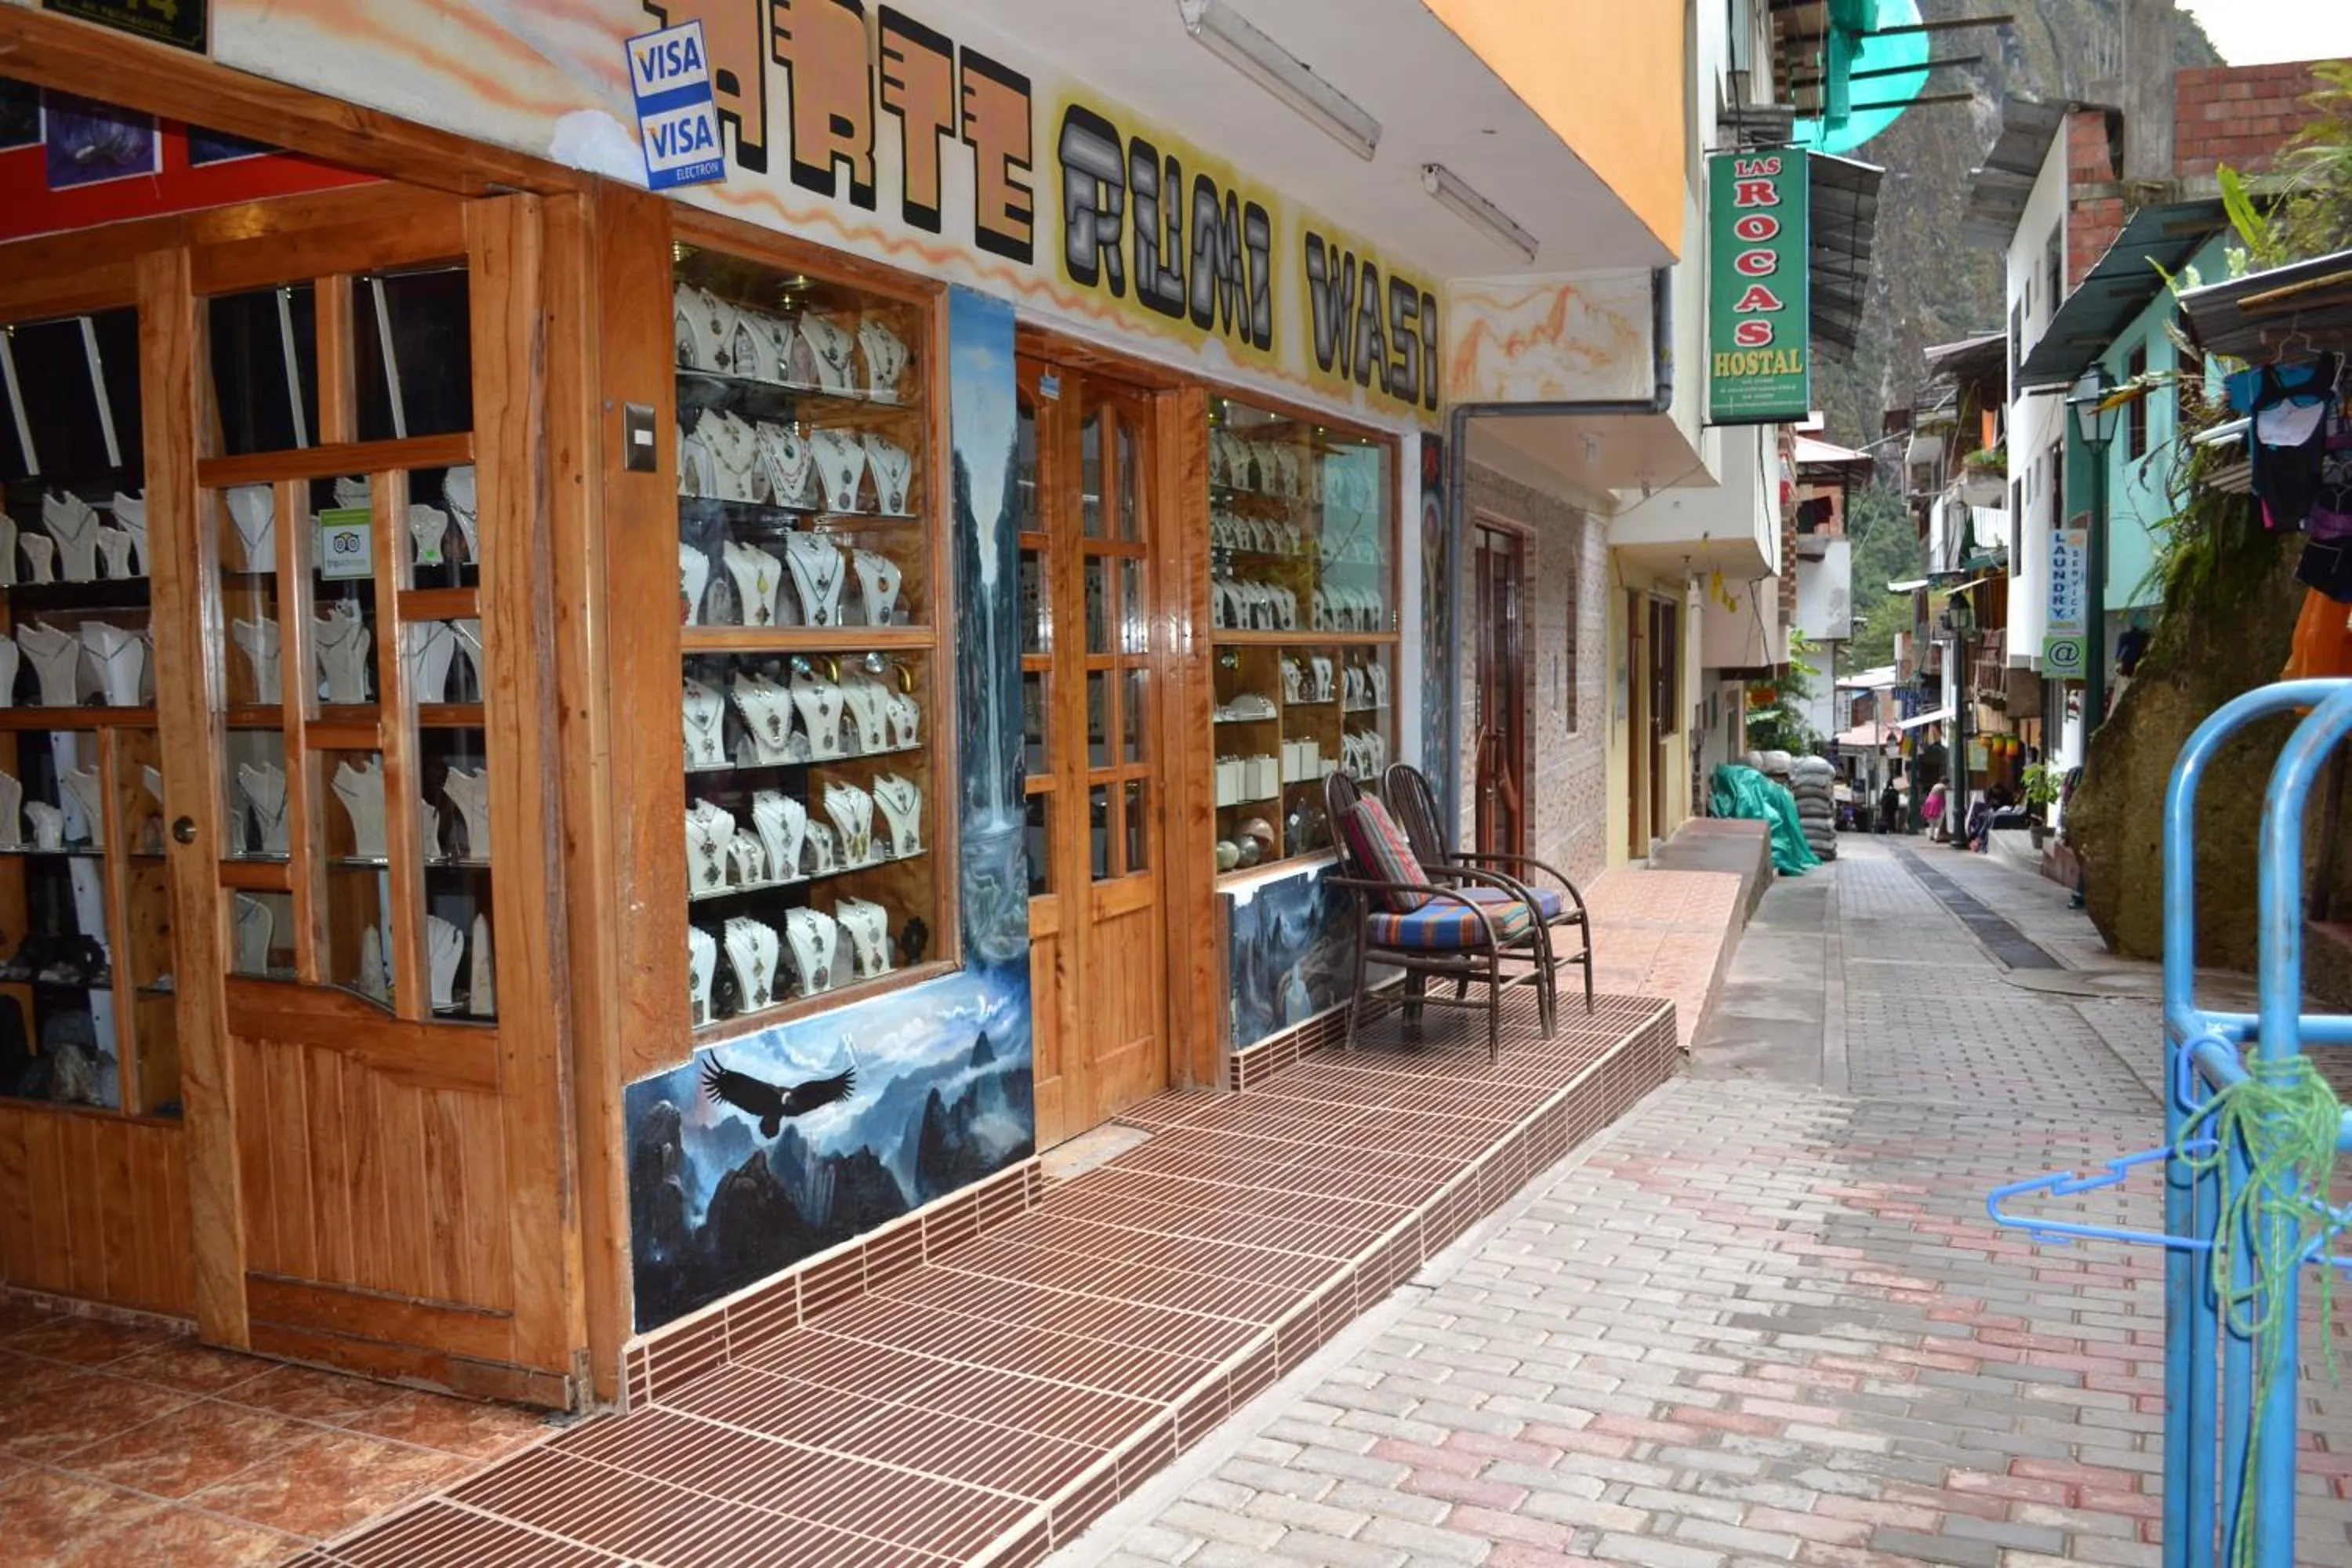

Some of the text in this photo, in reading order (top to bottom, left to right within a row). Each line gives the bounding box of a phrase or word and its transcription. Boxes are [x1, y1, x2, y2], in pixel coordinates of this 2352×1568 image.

[634, 37, 702, 82] VISA
[648, 114, 713, 158] VISA
[677, 160, 719, 181] ELECTRON
[1735, 157, 1781, 177] LAS
[643, 0, 1438, 411] ARTE RUMI WASI
[1733, 179, 1784, 347] ROCAS
[1715, 349, 1802, 377] HOSTAL
[2053, 532, 2066, 618] LAUNDRY
